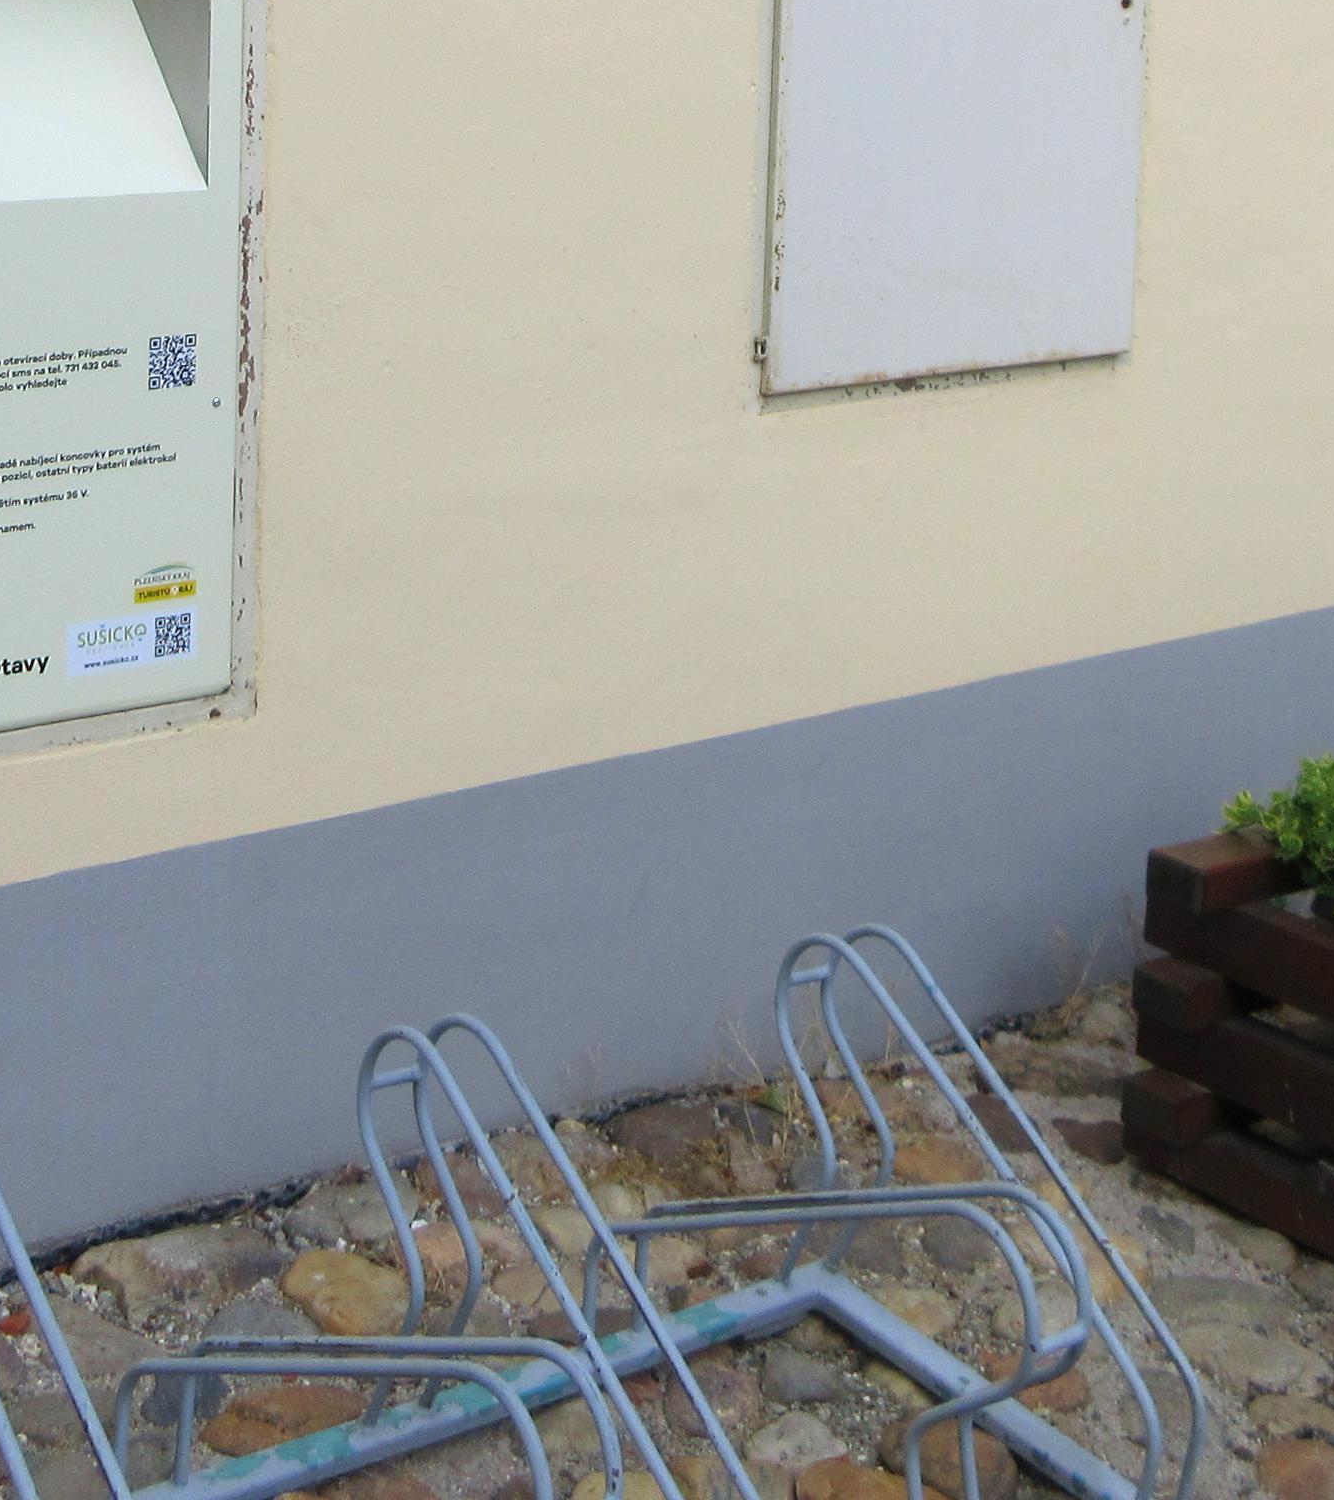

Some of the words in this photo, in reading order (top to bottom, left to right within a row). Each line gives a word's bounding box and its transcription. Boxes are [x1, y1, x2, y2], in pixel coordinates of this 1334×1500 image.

[3, 354, 48, 366] otevírací
[78, 346, 128, 359] Případnou
[12, 369, 31, 378] sms
[34, 367, 46, 376] na
[81, 360, 99, 370] 432
[16, 377, 67, 390] vyhledejte
[60, 450, 107, 463] koncovky
[108, 448, 125, 458] pro
[127, 443, 160, 455] systém
[36, 466, 69, 478] ostatní
[72, 464, 94, 475] typy
[96, 459, 127, 471] baterií
[129, 452, 177, 467] elektrokol
[23, 493, 64, 506] systému
[67, 490, 78, 500] 36
